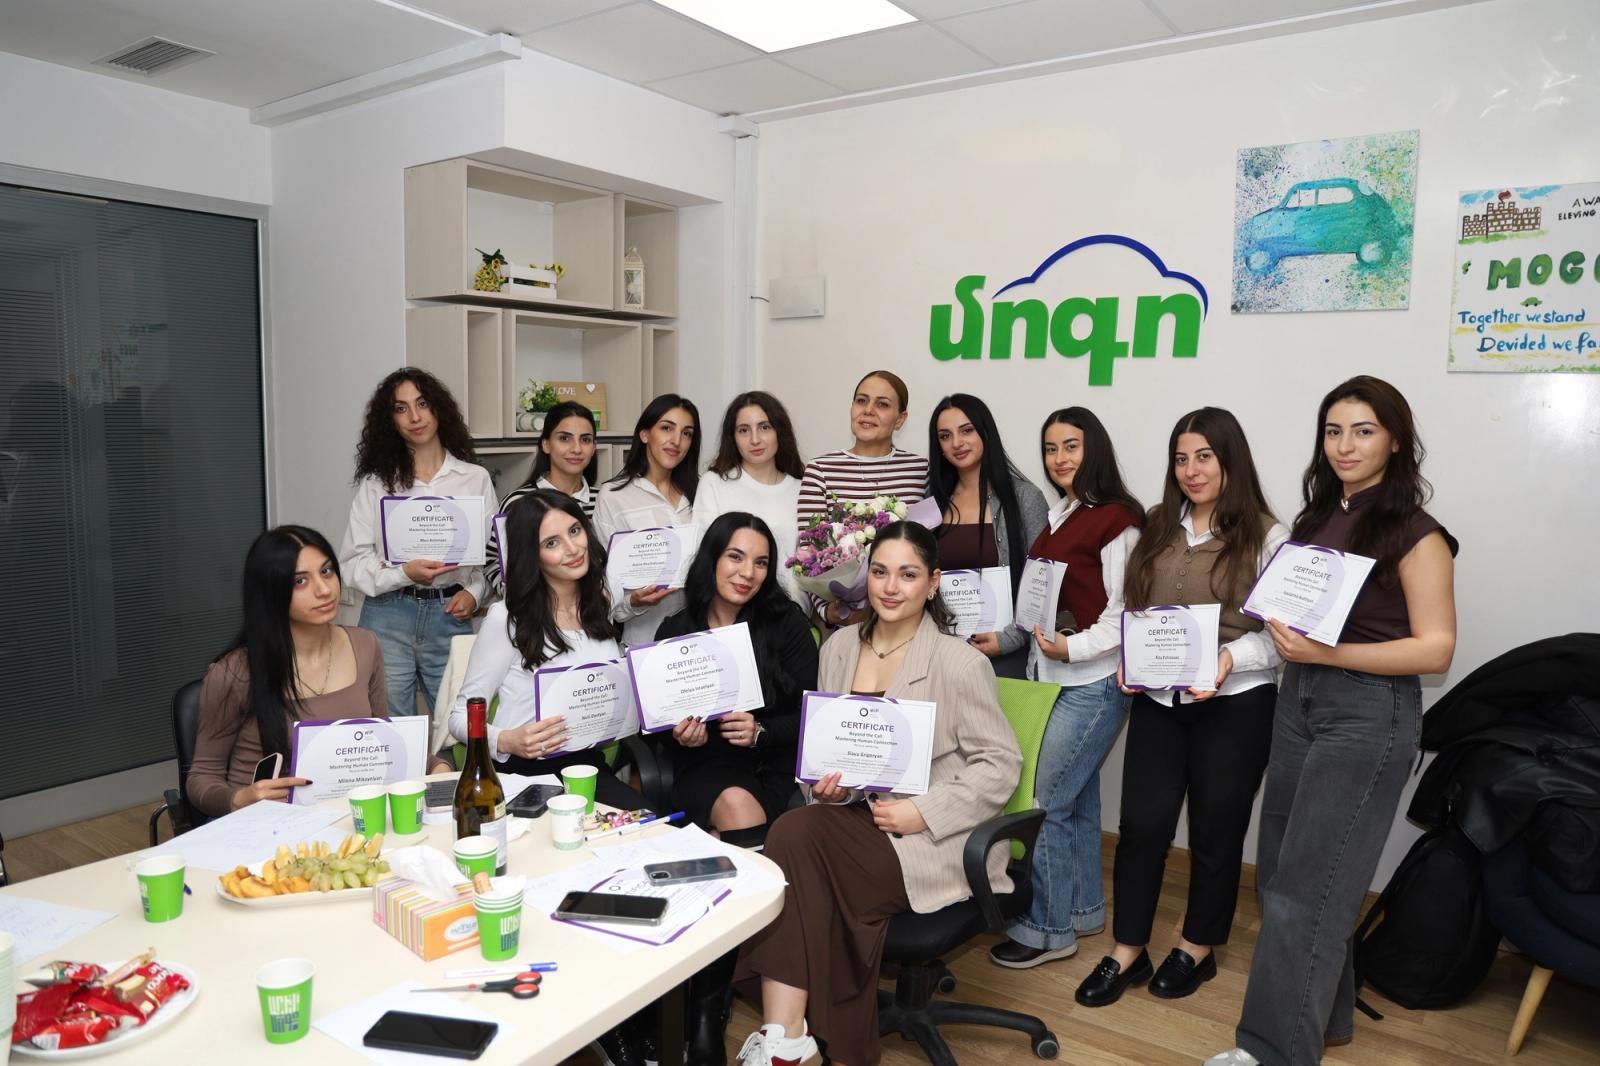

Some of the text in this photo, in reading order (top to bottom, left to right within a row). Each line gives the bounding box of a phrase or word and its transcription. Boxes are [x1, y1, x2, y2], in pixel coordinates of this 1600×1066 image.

[1572, 198, 1581, 208] A
[1487, 251, 1600, 290] MOG
[1458, 308, 1586, 333] Together we stand
[1477, 332, 1600, 354] Devided we fa
[1293, 565, 1332, 581] CERTIFICATE
[667, 654, 717, 670] CERTIFICATE
[573, 683, 616, 697] CERTIFICATE
[841, 721, 895, 732] CERTIFICATE
[335, 744, 390, 756] CERTIFICATE
